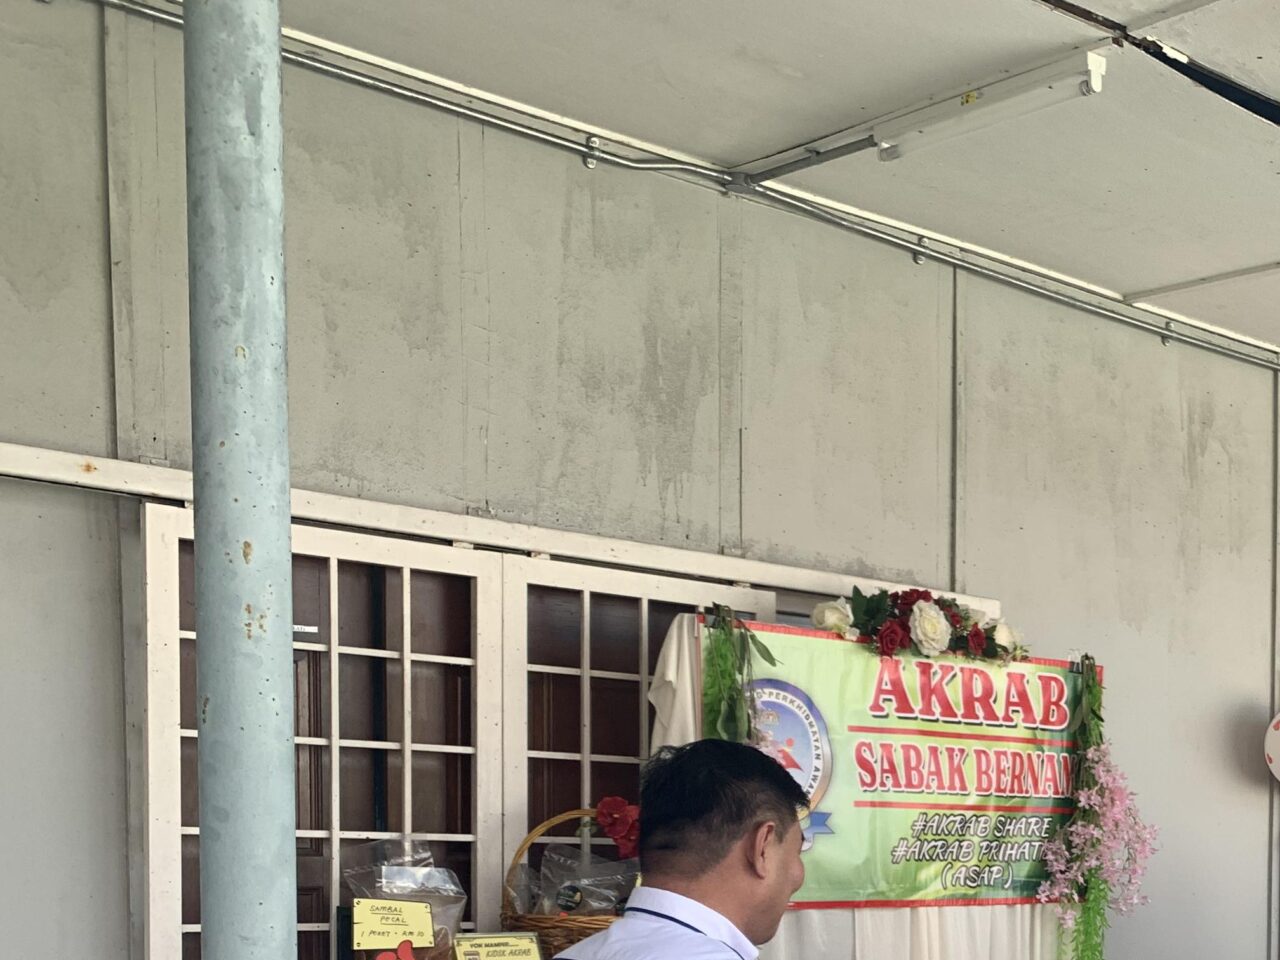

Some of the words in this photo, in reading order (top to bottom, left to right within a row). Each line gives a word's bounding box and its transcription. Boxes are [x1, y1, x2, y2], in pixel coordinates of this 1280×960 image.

[868, 656, 1070, 730] AKRAB
[854, 739, 968, 796] SABAK
[911, 812, 990, 837] #AKRAB
[994, 816, 1052, 838] SHARE
[891, 838, 974, 865] #AKRAB
[369, 904, 403, 913] SAMBAL
[380, 915, 407, 923] PECAL
